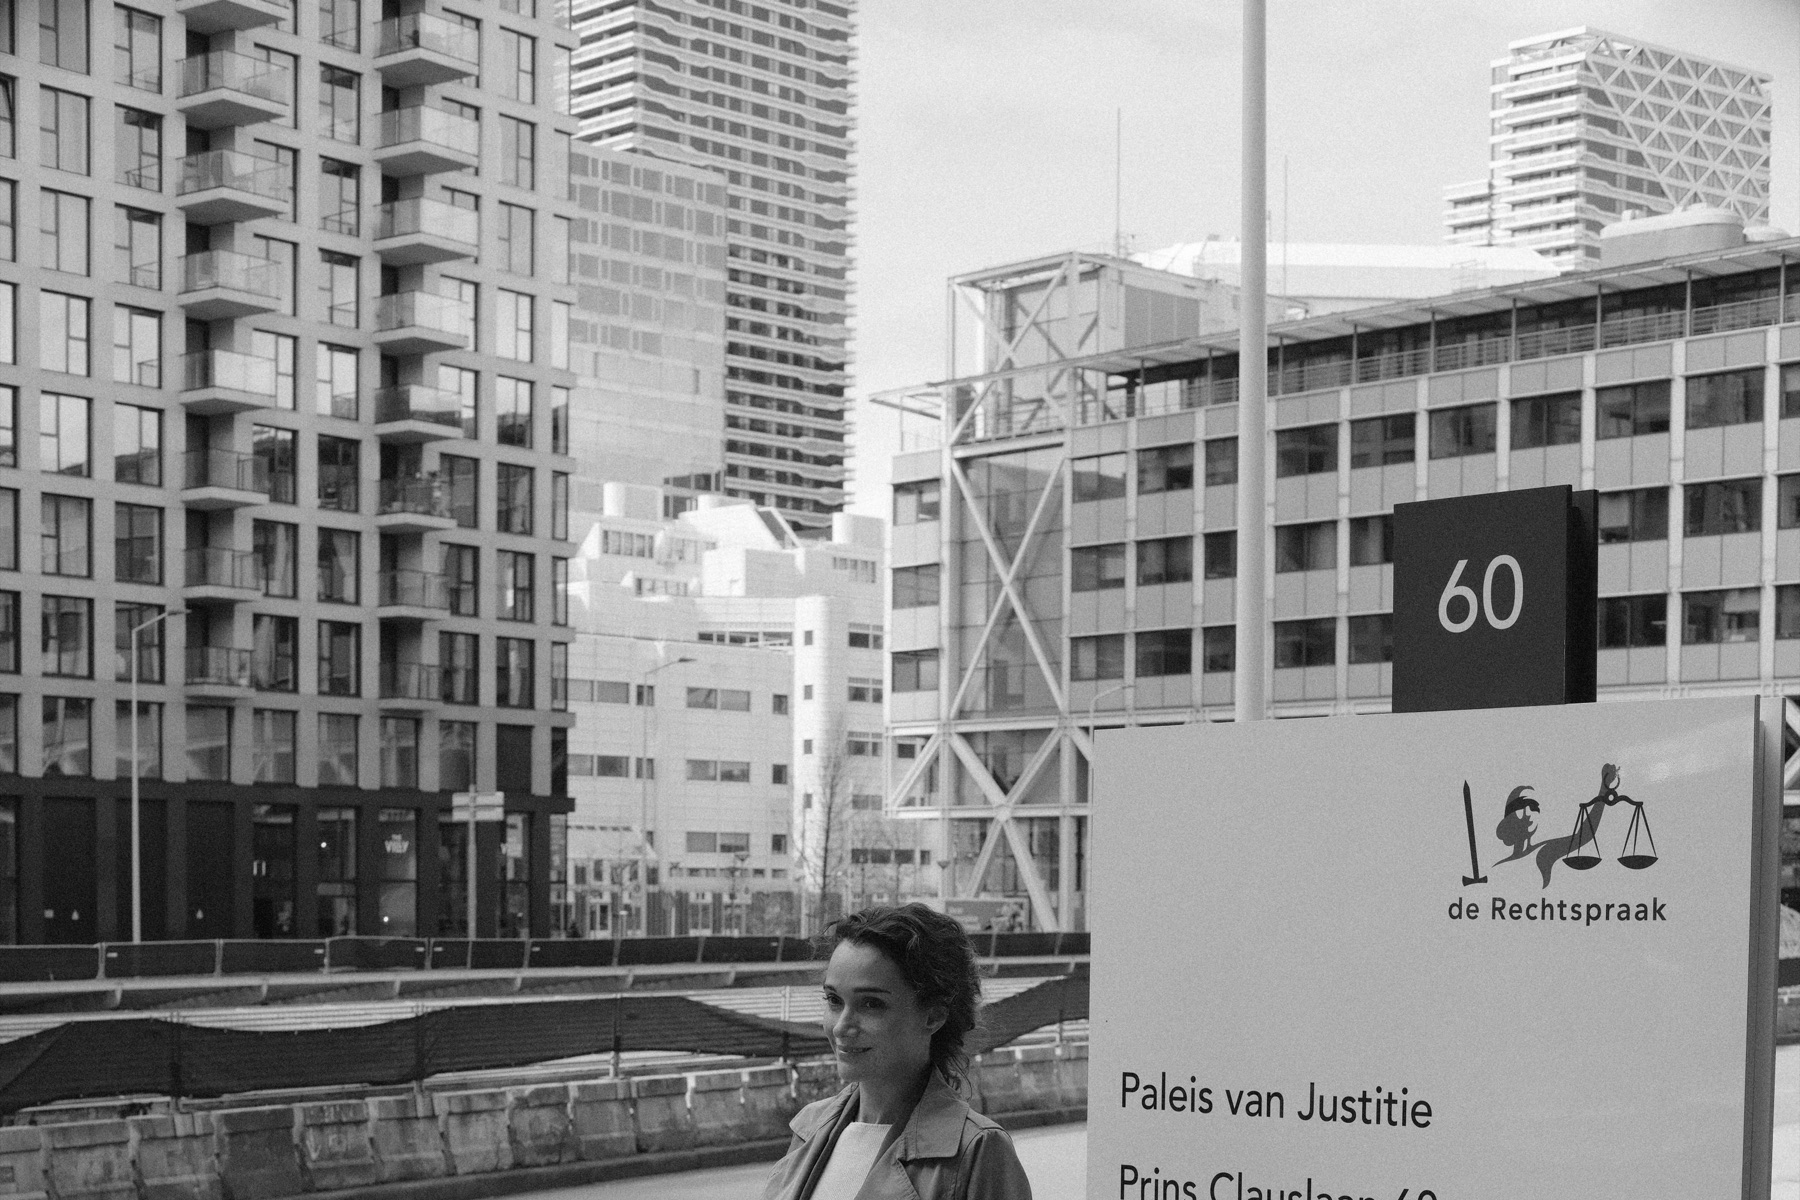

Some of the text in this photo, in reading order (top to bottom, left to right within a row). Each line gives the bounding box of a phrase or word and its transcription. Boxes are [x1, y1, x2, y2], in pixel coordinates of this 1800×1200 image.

[1438, 554, 1524, 633] 60
[1448, 897, 1666, 927] de Rechtspraak
[1121, 1071, 1433, 1129] Paleis van Justitie
